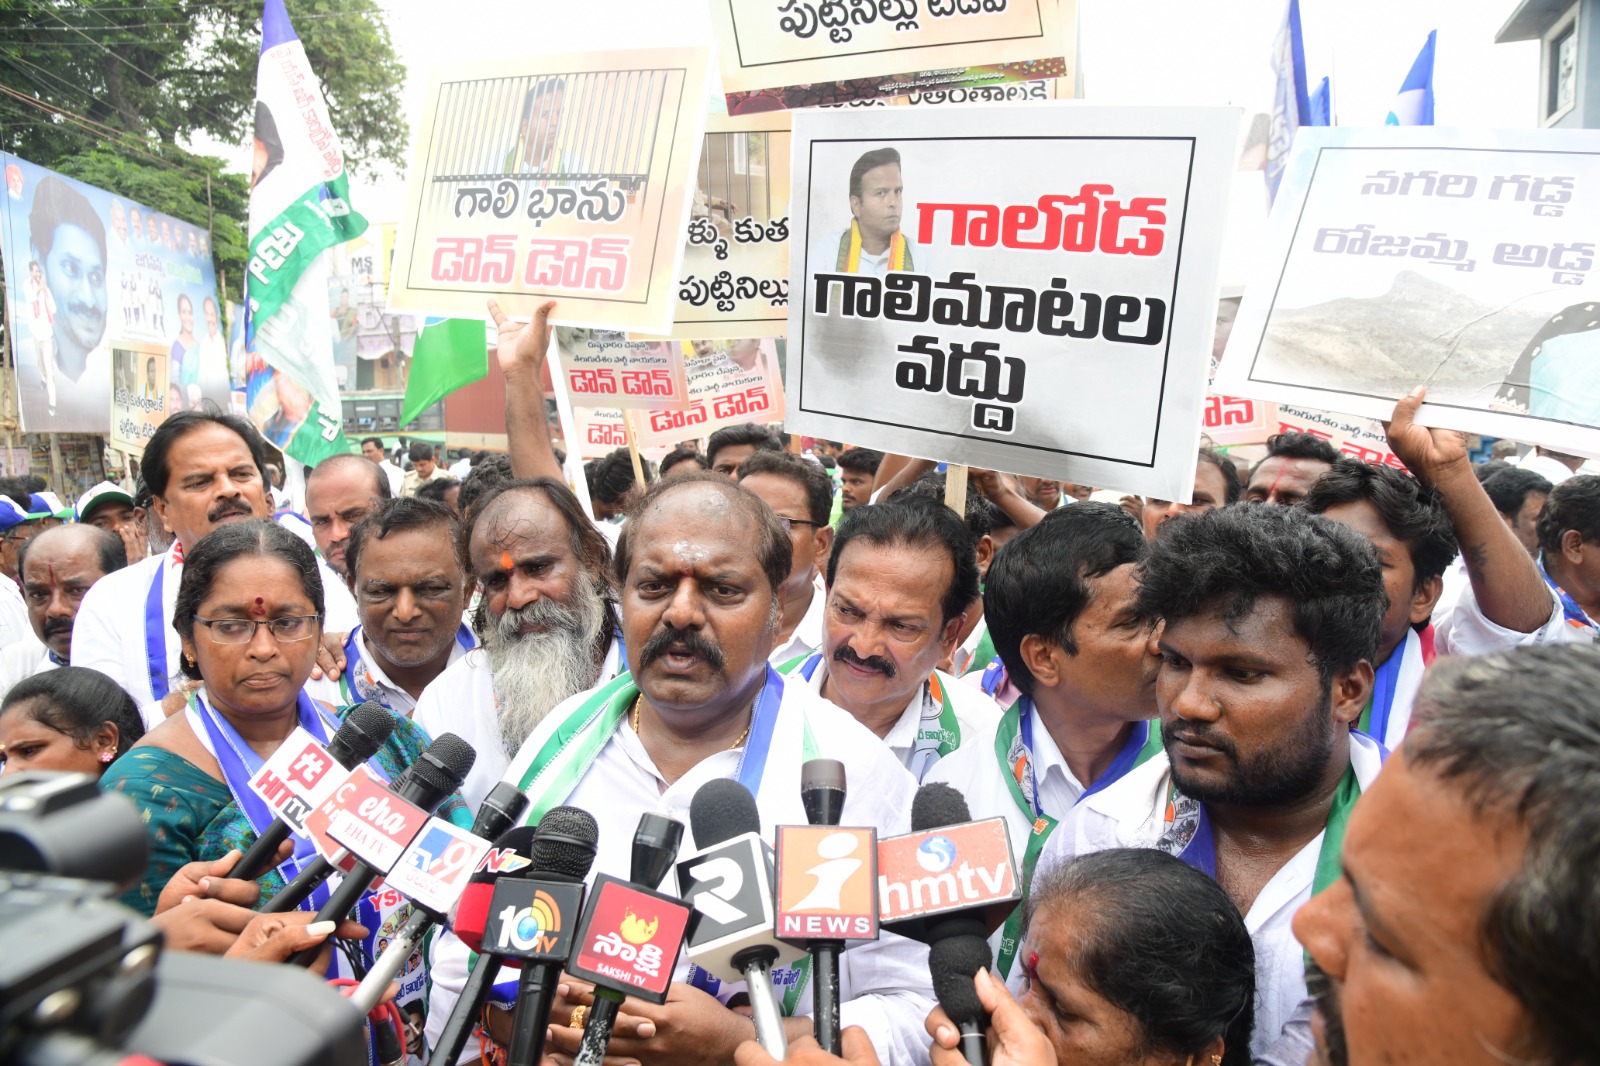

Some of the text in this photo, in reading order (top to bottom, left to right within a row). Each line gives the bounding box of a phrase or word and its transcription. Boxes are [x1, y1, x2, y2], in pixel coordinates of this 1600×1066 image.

[454, 180, 627, 228] గాలి భాను
[1361, 169, 1575, 217] నగరి గడ్డ
[916, 183, 1167, 257] గాలోడ
[430, 233, 631, 292] డౌన్ డౌన్
[1312, 223, 1597, 286] రోజమ్మ అడ్డ
[813, 271, 1167, 346] గాలిమాటల
[569, 368, 673, 396] డౌన్ డౌన్
[712, 385, 769, 419] డౌన్
[895, 335, 1027, 433] వద్దు
[255, 769, 297, 808] HIT
[343, 821, 372, 848] EHA
[878, 860, 1008, 914] hmtv
[535, 936, 558, 954] TV
[784, 916, 871, 935] NEWS
[593, 931, 664, 978] సాక్షి
[596, 962, 646, 986] SAKSHI TV
